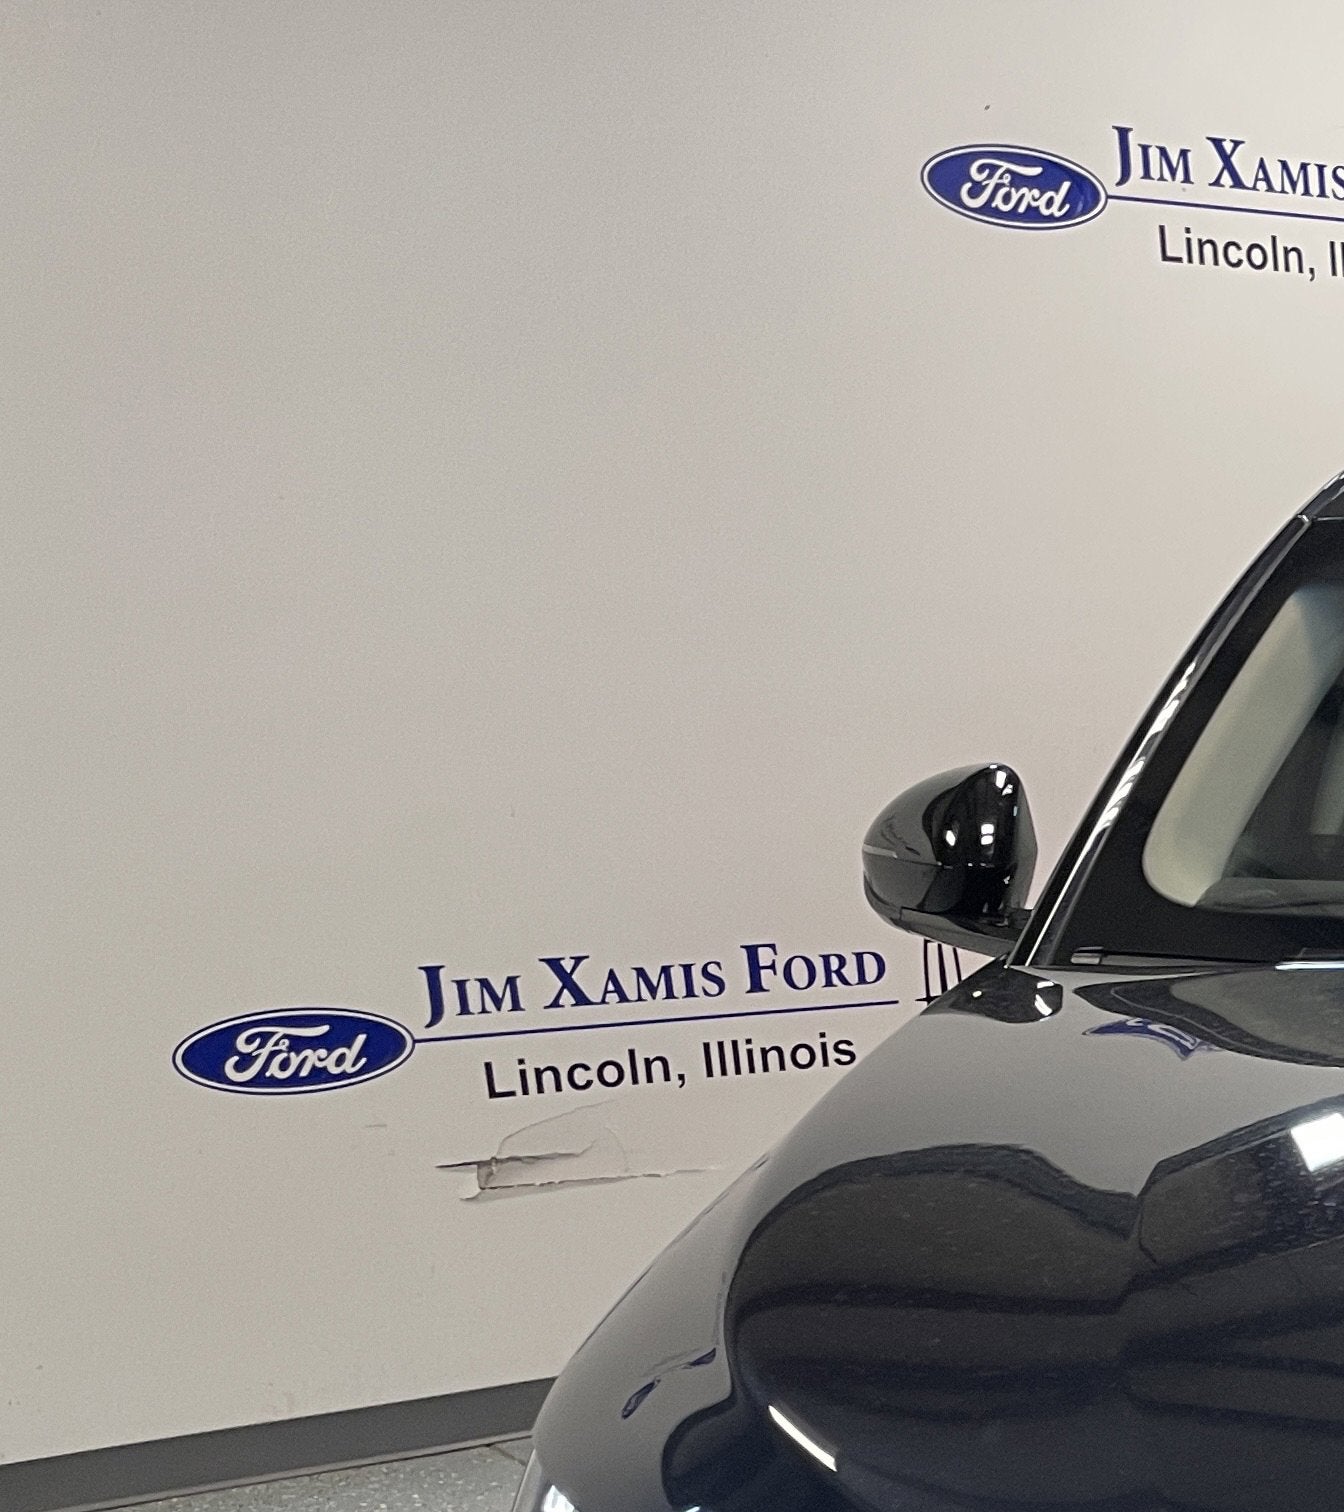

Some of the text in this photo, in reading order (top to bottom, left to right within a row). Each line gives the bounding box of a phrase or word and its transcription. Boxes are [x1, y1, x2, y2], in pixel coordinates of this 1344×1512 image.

[1112, 125, 1193, 187] JIM
[961, 157, 1071, 219] Ford
[1158, 224, 1318, 282] Lincoln,
[418, 942, 887, 1030] JIM XAMIS FORD
[223, 1024, 368, 1083] Ford
[484, 1031, 858, 1101] Lincoln, Illinois
